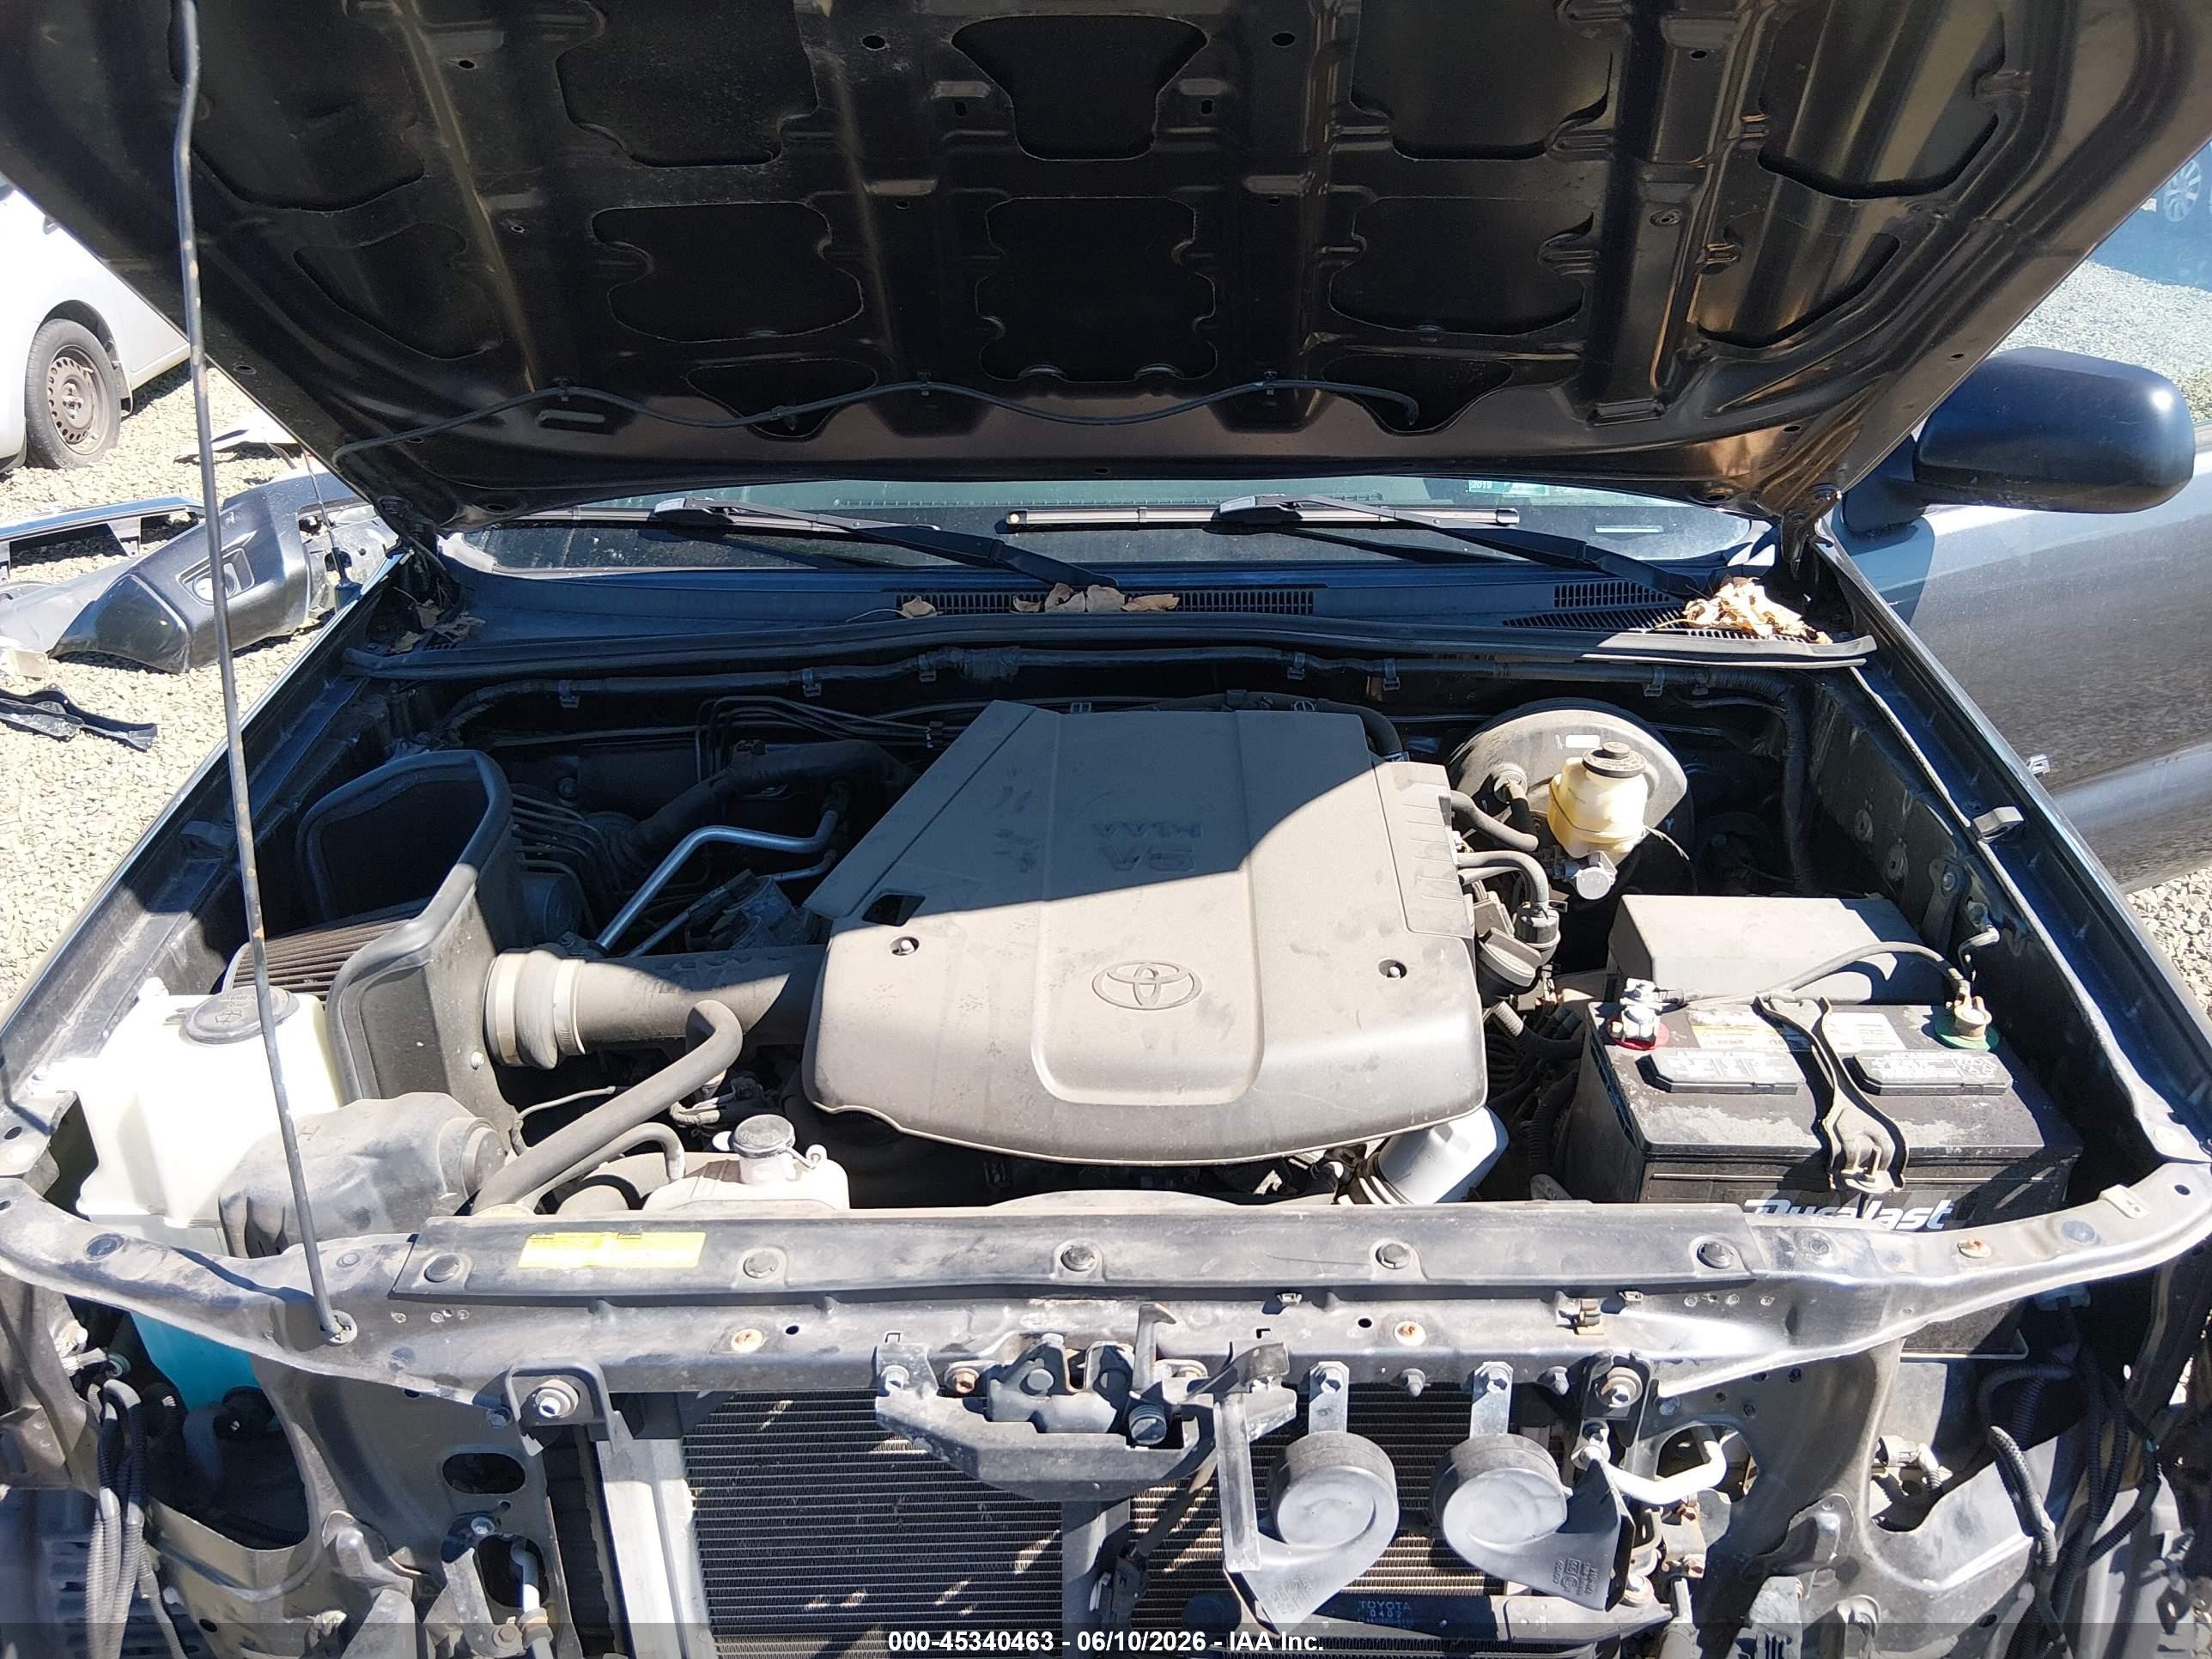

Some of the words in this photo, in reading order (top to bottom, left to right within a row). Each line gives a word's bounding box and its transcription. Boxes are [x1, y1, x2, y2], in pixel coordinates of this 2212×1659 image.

[1472, 481, 1492, 489] 2019
[1099, 844, 1196, 872] V6
[1358, 1600, 1412, 1612] TOYOTA
